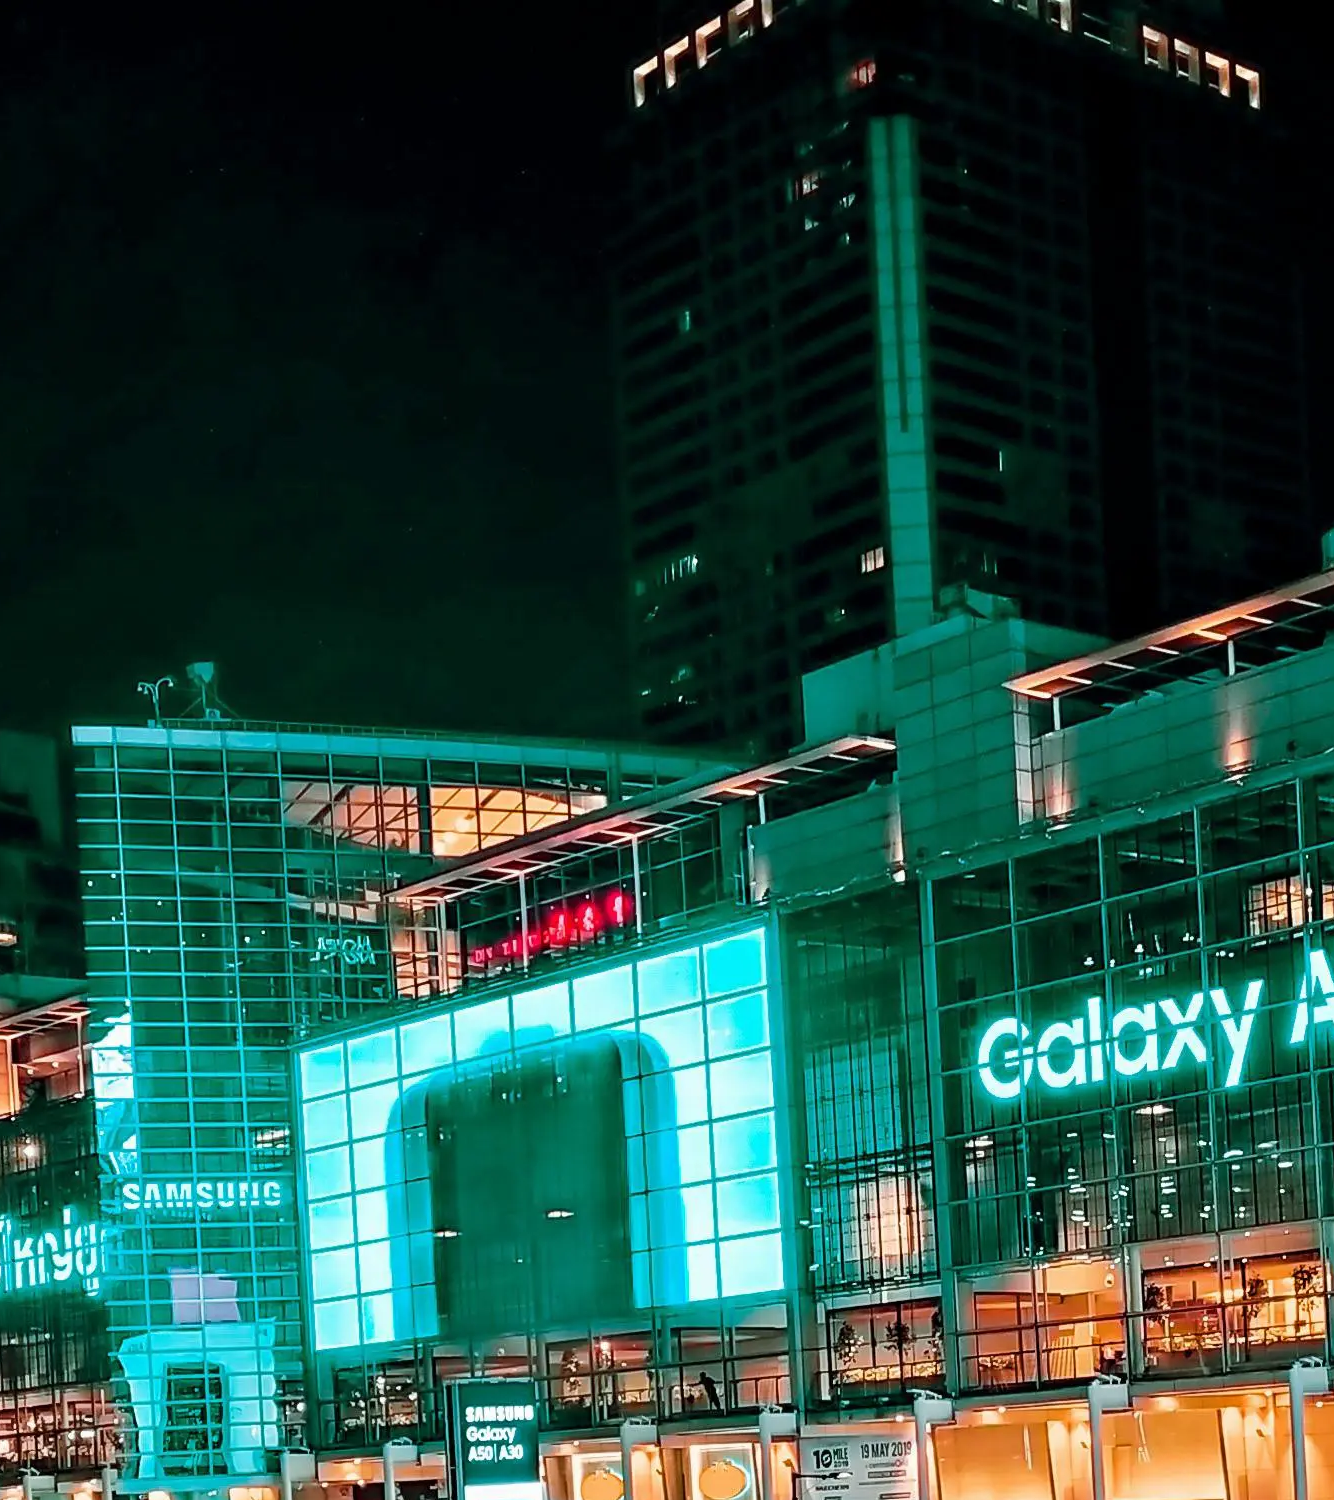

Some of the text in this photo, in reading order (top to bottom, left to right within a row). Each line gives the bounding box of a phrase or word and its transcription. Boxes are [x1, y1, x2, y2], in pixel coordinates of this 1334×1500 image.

[977, 980, 1263, 1098] Galaxy
[122, 1181, 282, 1211] SAMSUNG
[465, 1405, 534, 1422] SAMSUNG
[466, 1426, 517, 1443] Galaxy
[468, 1445, 494, 1462] A50
[499, 1444, 524, 1461] A30
[832, 1446, 849, 1460] MILE
[860, 1441, 912, 1459] 19 MAY 2019
